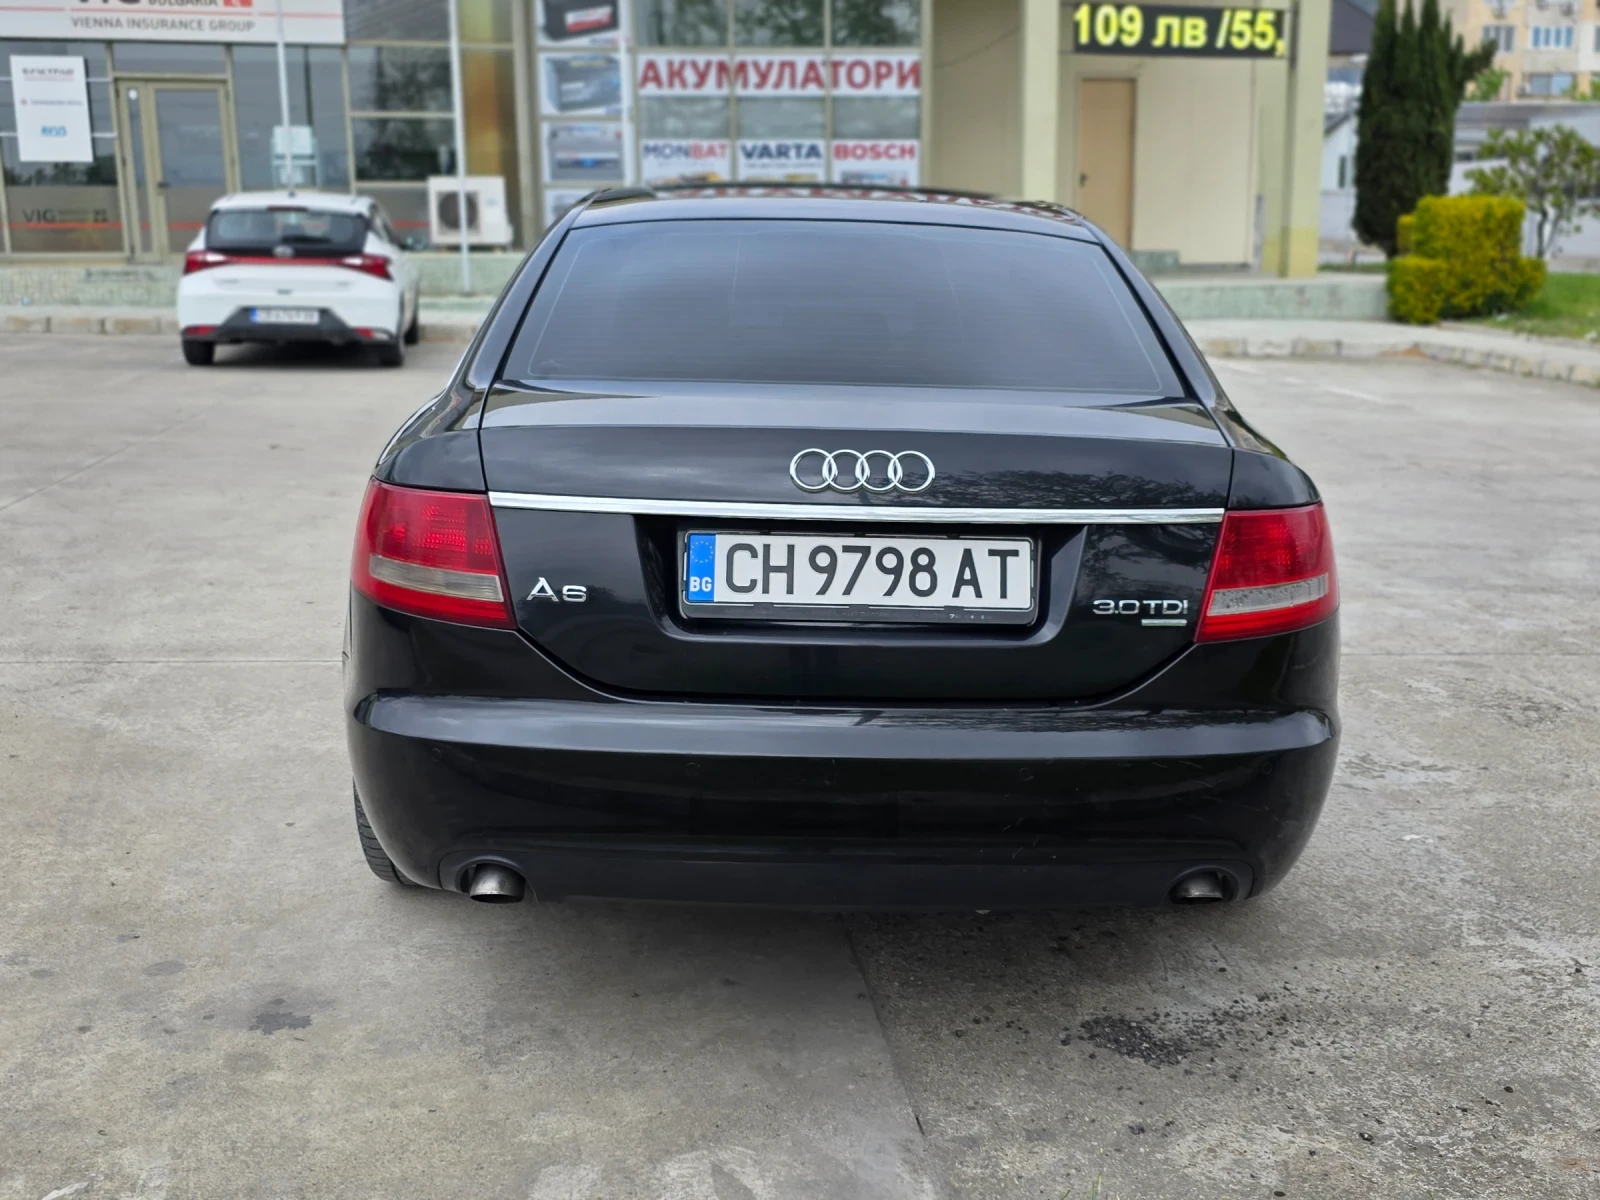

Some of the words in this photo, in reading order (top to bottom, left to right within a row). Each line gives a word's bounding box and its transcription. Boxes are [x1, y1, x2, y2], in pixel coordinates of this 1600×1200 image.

[71, 16, 123, 28] VIENNA
[127, 17, 205, 31] INSURANCE
[209, 19, 255, 32] GROUP
[1074, 3, 1143, 46] 109
[1152, 16, 1207, 48] лв
[639, 59, 922, 90] АКУМУЛАТОРИ
[643, 143, 728, 160] MONBAT
[740, 143, 822, 160] VARTA
[833, 143, 916, 160] BOSCH
[726, 543, 795, 595] CH
[808, 545, 938, 598] 9798
[951, 548, 1020, 599] AT
[526, 576, 587, 602] A6
[689, 576, 712, 592] BG
[1092, 599, 1140, 615] 3.0
[1142, 599, 1188, 615] TDI
